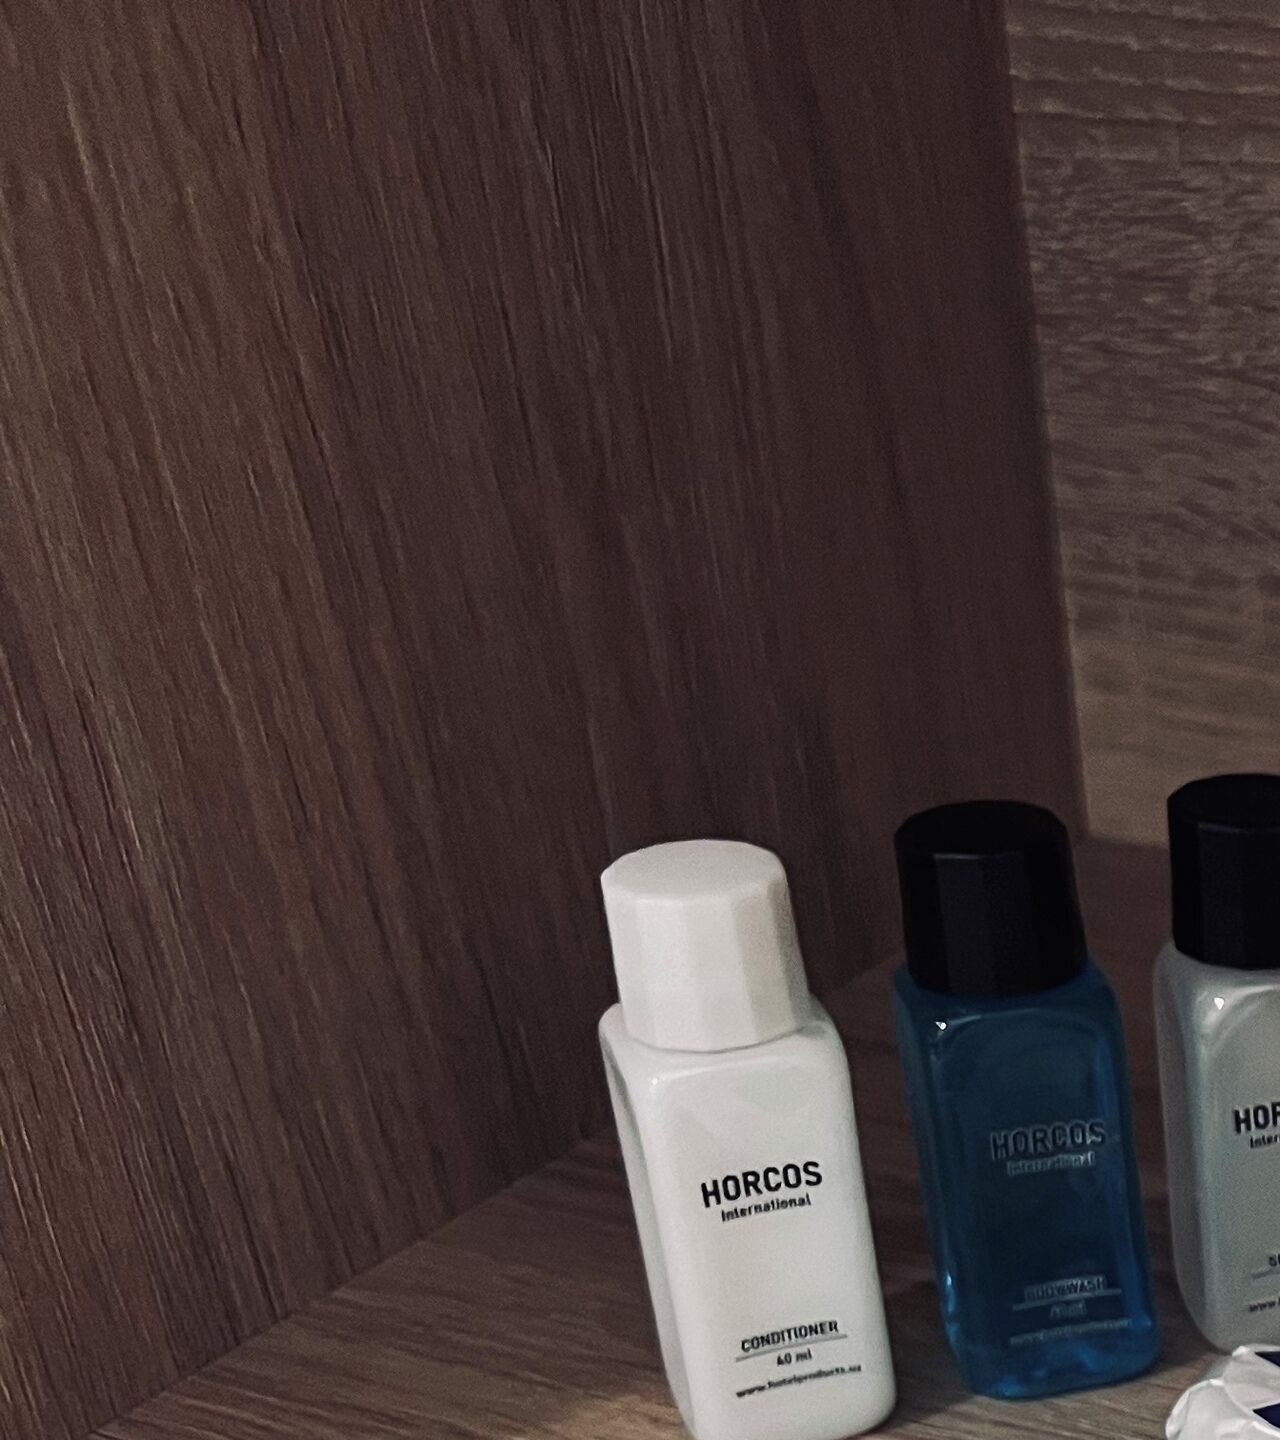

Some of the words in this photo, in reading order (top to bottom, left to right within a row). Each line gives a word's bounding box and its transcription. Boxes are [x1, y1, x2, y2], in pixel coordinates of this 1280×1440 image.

[991, 1121, 1106, 1161] HORCOS
[701, 1161, 822, 1208] HORCOS
[721, 1192, 811, 1222] International
[741, 1320, 839, 1352] CONDITIONER
[796, 1347, 812, 1362] ml
